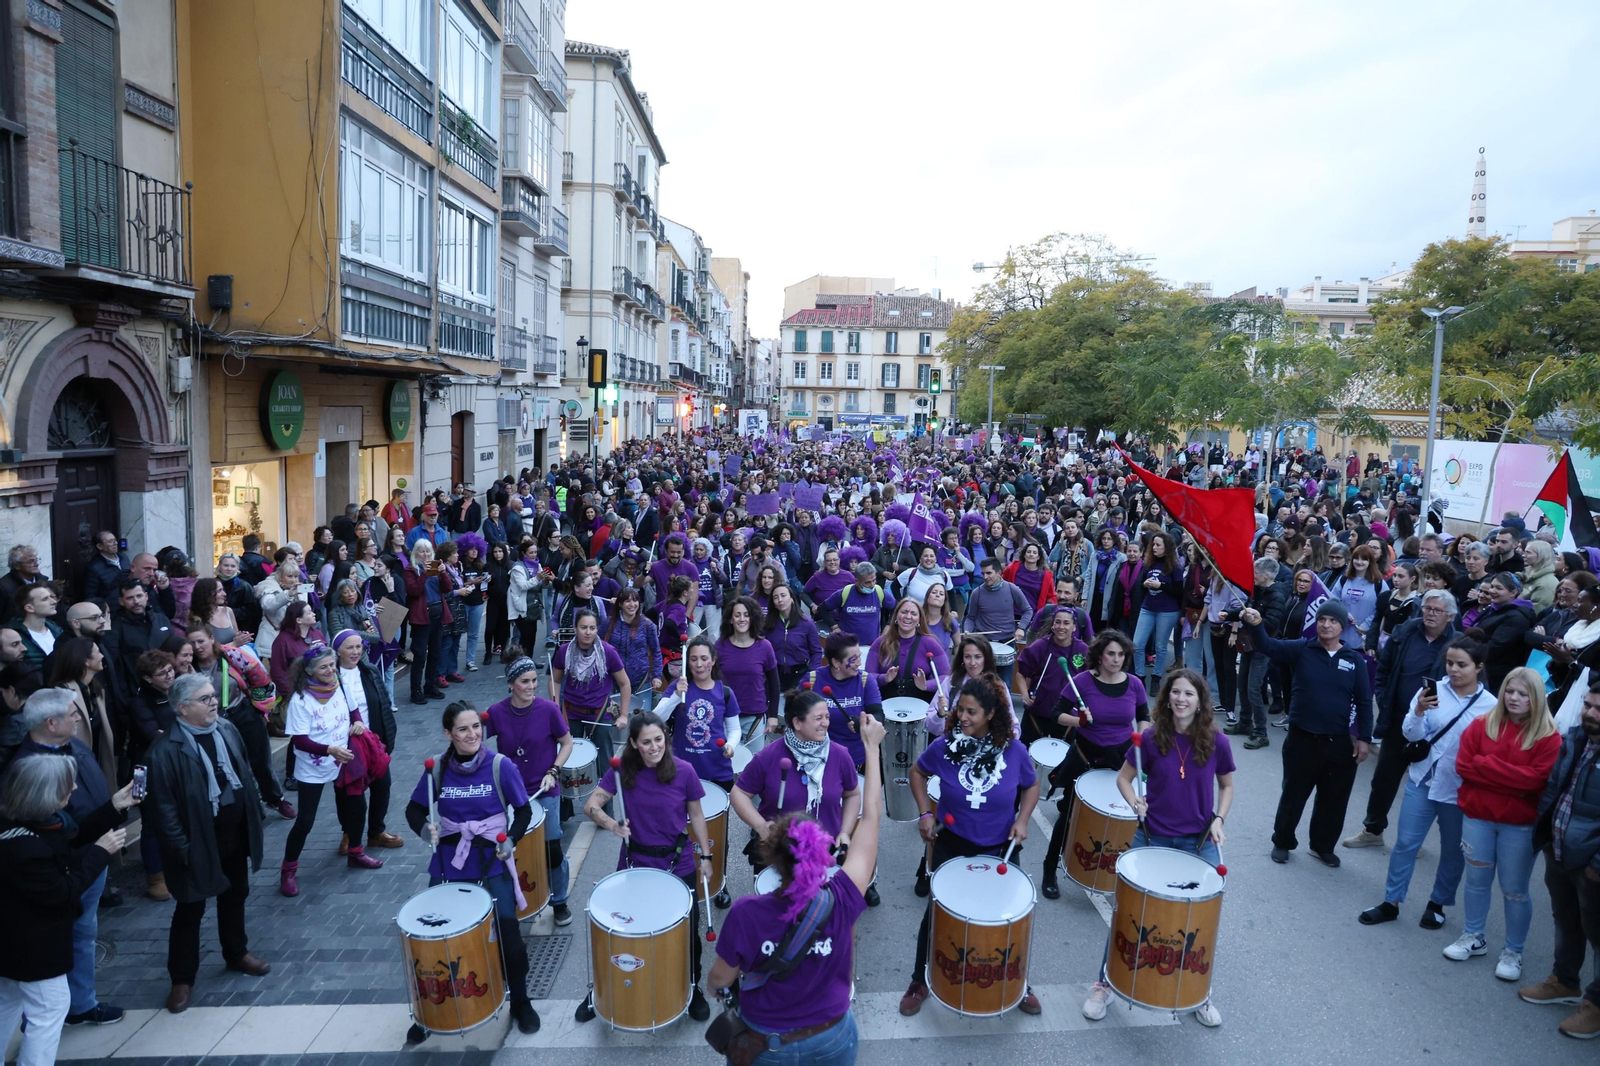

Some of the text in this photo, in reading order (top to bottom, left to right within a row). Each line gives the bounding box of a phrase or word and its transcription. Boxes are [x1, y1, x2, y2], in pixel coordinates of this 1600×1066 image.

[277, 385, 298, 402] JOAN
[394, 391, 408, 404] JOAN
[1469, 463, 1483, 471] EXPO
